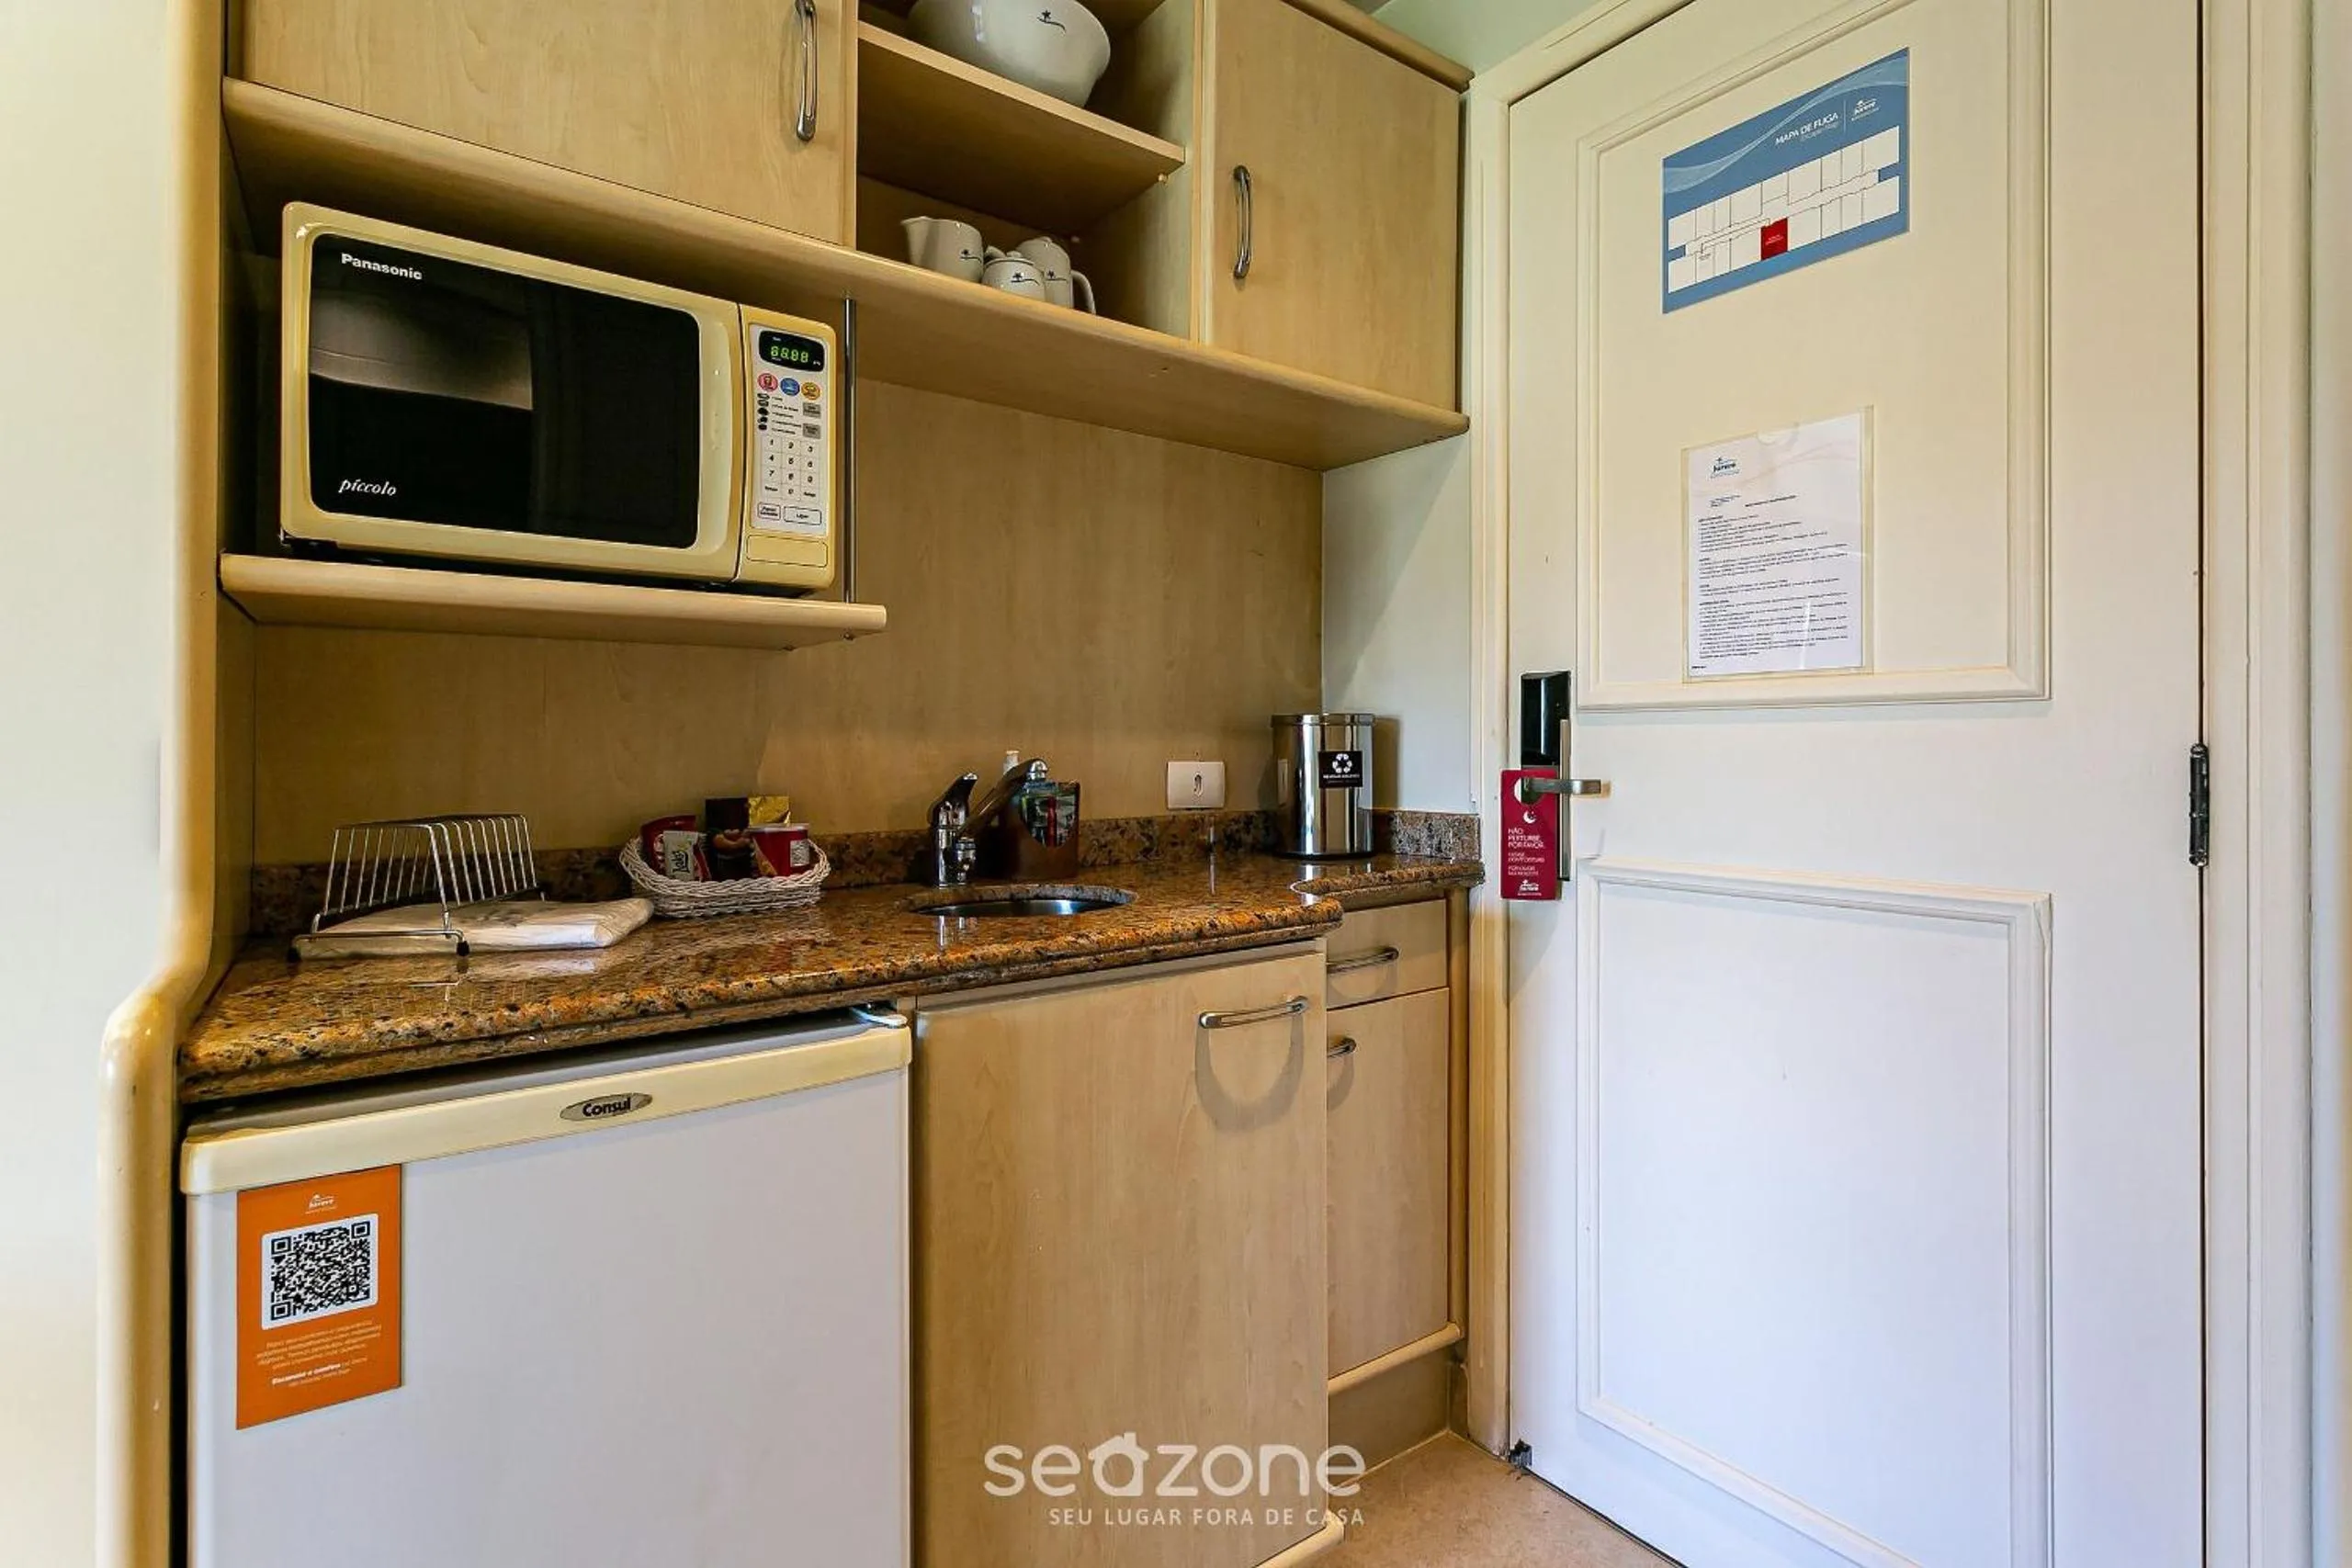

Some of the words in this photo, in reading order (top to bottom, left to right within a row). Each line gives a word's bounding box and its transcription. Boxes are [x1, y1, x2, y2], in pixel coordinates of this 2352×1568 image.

[1775, 130, 1800, 145] MAPA
[1801, 122, 1813, 135] DE
[1814, 112, 1838, 129] FUGA
[341, 253, 423, 280] Panasonic
[338, 479, 397, 496] piccolo
[582, 1097, 631, 1117] Consul
